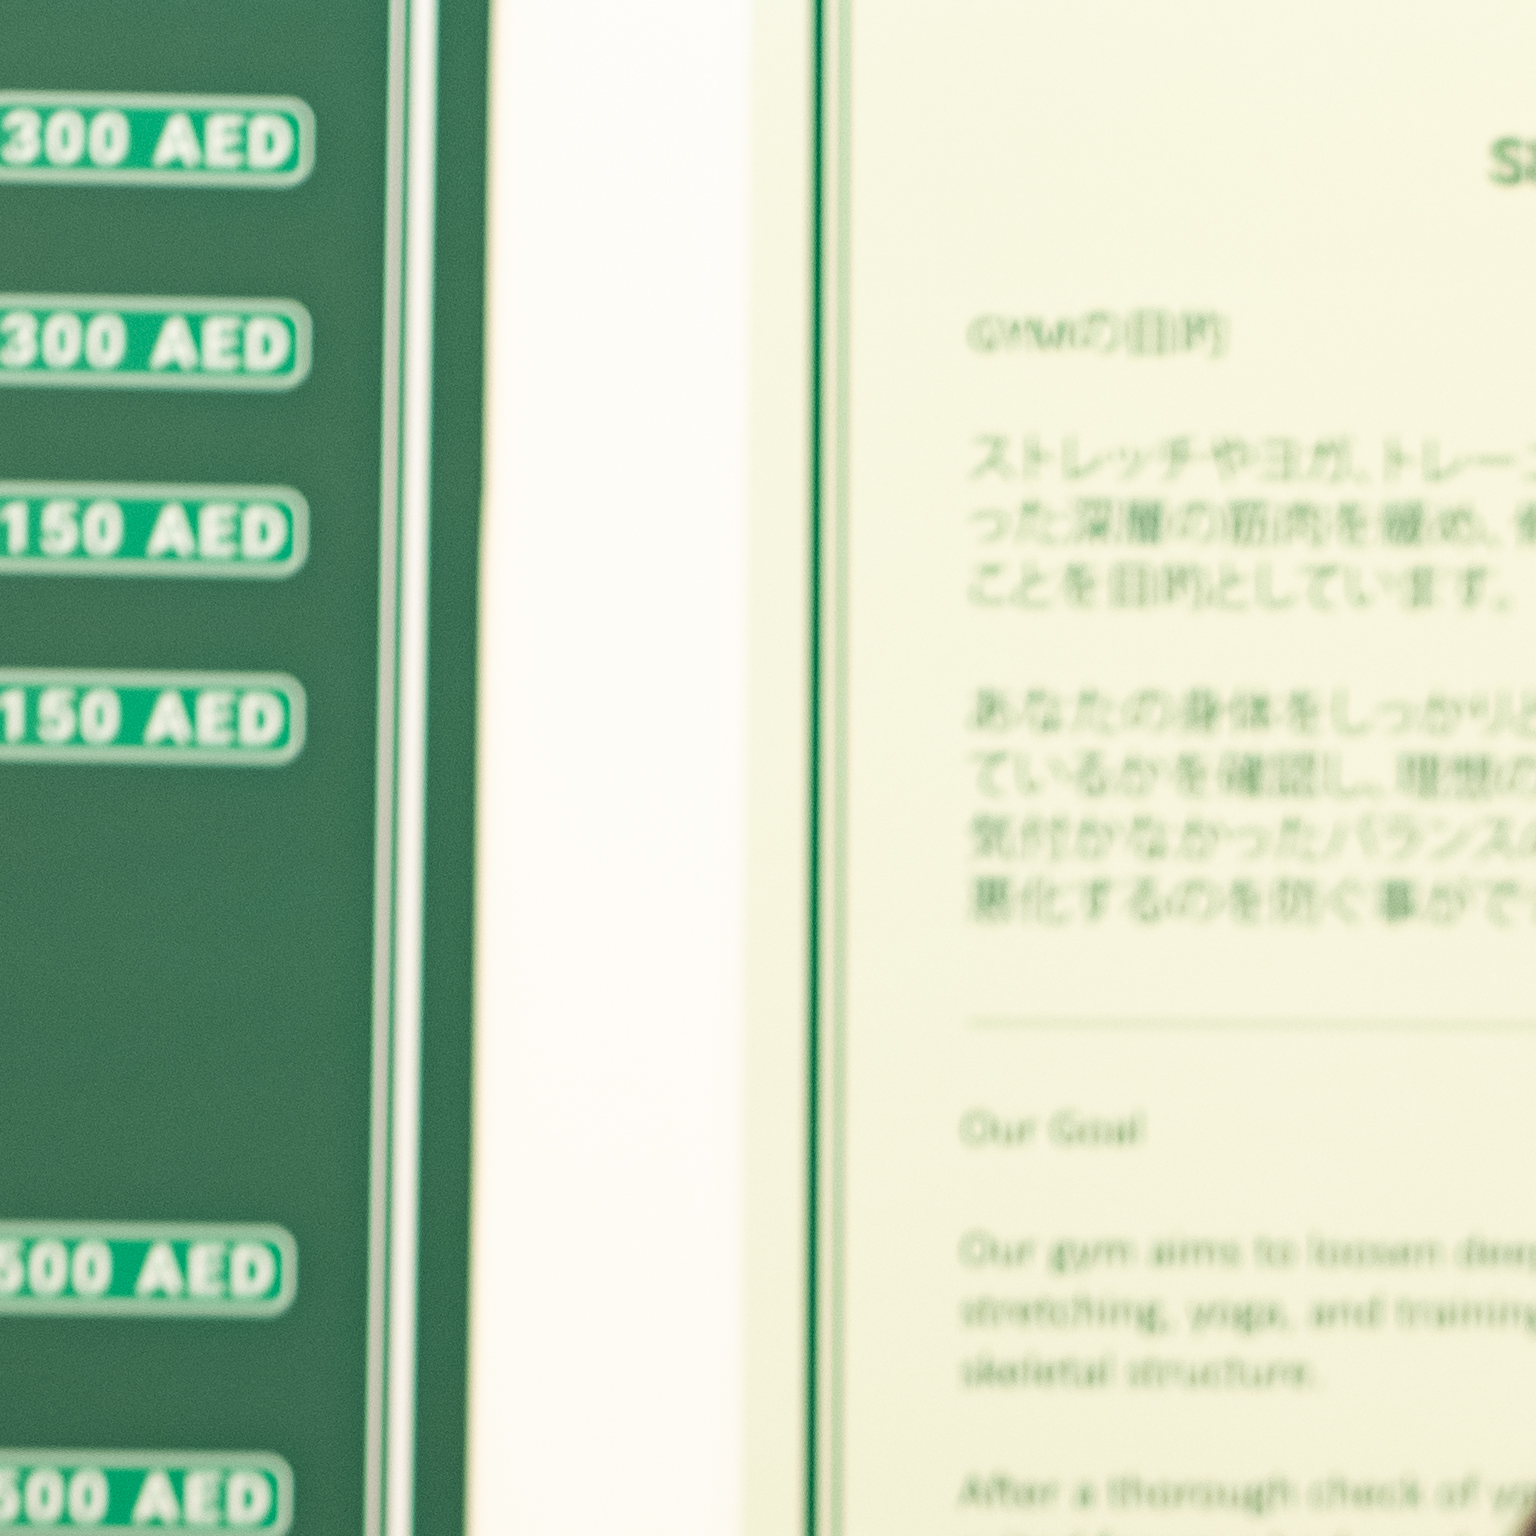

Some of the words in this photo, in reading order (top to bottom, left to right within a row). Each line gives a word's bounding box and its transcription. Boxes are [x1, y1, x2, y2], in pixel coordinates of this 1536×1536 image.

[0, 108, 131, 164] 300
[153, 111, 296, 169] AED
[0, 310, 127, 368] 300
[149, 313, 293, 371] AED
[966, 308, 1231, 358] GYMの目的
[0, 498, 125, 555] 150
[146, 501, 289, 558] AED
[0, 687, 122, 743] 150
[143, 690, 286, 747] AED
[957, 1109, 1038, 1149] Our
[1048, 1108, 1144, 1149] Goal
[135, 1241, 278, 1297] AED
[957, 1230, 1037, 1269] Our
[1046, 1238, 1137, 1277] gym
[1148, 1236, 1243, 1269] aims
[1253, 1236, 1298, 1268] to
[1307, 1236, 1444, 1269] loosen
[957, 1293, 1174, 1338] stretching,
[1187, 1298, 1292, 1339] yoga,
[1307, 1295, 1387, 1330] and
[957, 1354, 1116, 1390] skeletal
[1125, 1356, 1315, 1391] structure.
[132, 1470, 273, 1525] AED
[956, 1471, 1061, 1510] After
[1074, 1480, 1098, 1511] a
[1105, 1474, 1298, 1519] thorough
[1307, 1475, 1424, 1511] check
[1435, 1474, 1482, 1511] of
